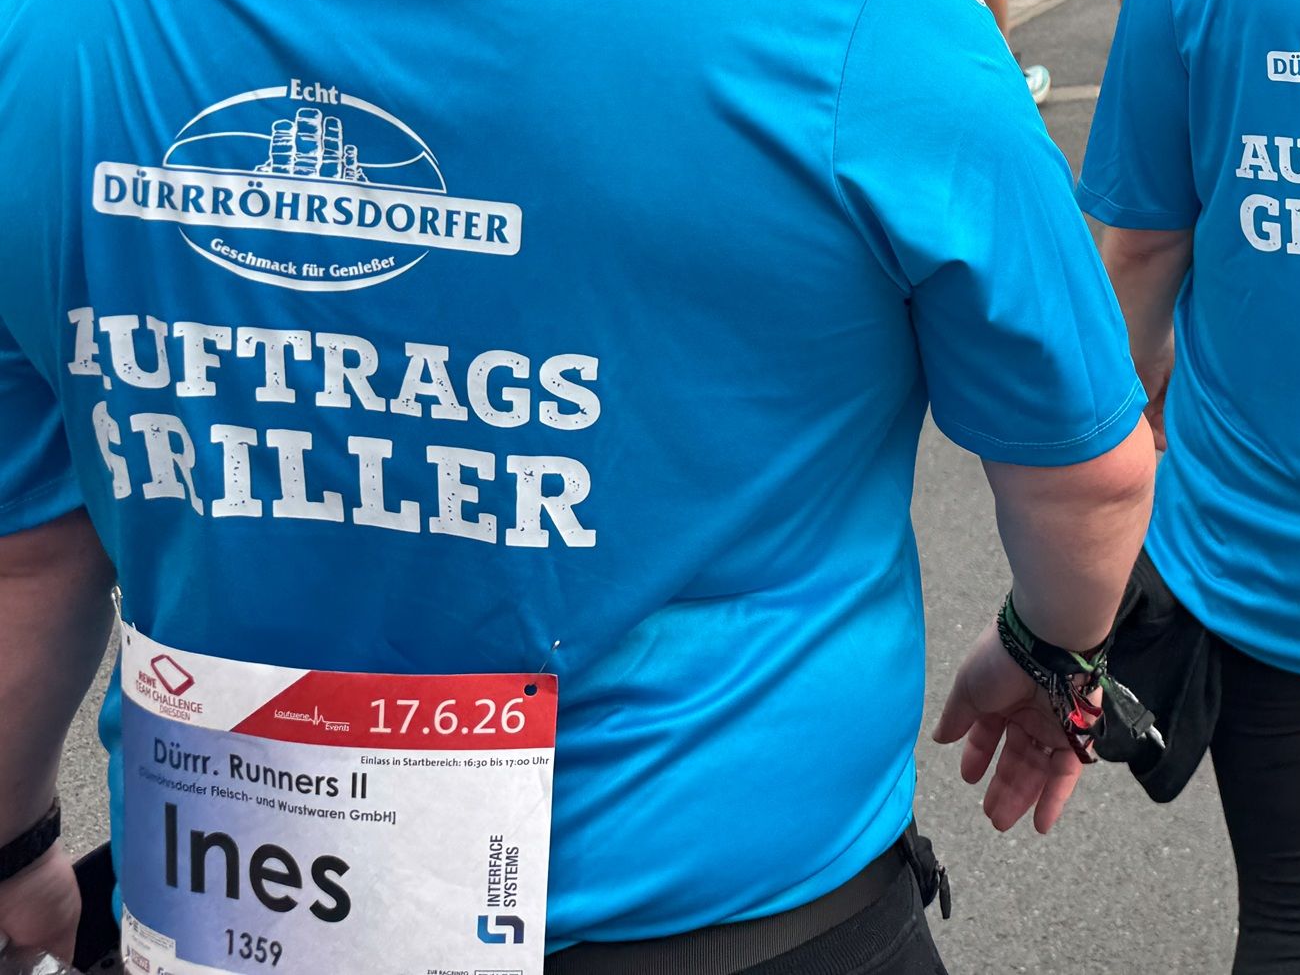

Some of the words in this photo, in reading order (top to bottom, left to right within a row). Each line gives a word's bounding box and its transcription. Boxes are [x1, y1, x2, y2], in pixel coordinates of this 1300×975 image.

[289, 78, 340, 106] Echt
[102, 170, 511, 245] DÜRRRÖHRSDORFER
[210, 238, 298, 275] Geschmack
[302, 263, 326, 277] für
[329, 255, 396, 277] Genießer
[67, 306, 602, 431] AUFTRAGS
[91, 400, 597, 548] GRILLER
[136, 680, 151, 699] TEAM
[152, 690, 204, 714] CHALLENGE
[138, 670, 157, 689] REWE
[159, 705, 191, 721] DRESDEN
[325, 722, 350, 732] Events
[369, 697, 526, 735] 17.6.26
[154, 737, 219, 776] Dürrr.
[229, 753, 340, 797] Runners
[350, 772, 367, 799] II
[360, 756, 391, 766] Einlass
[392, 756, 401, 766] in
[403, 756, 462, 767] Startbereich:
[463, 758, 488, 768] 16:30
[489, 756, 503, 767] bis
[505, 758, 530, 768] 17:00
[532, 756, 550, 766] Uhr
[211, 785, 253, 802] Fleisch-
[256, 795, 275, 809] und
[277, 799, 346, 820] Wurstwaren
[350, 809, 397, 825] GmbH]
[164, 802, 352, 923] Ines
[486, 833, 504, 907] INTERFACE
[503, 846, 519, 908] SYSTEMS
[225, 929, 283, 967] 1359
